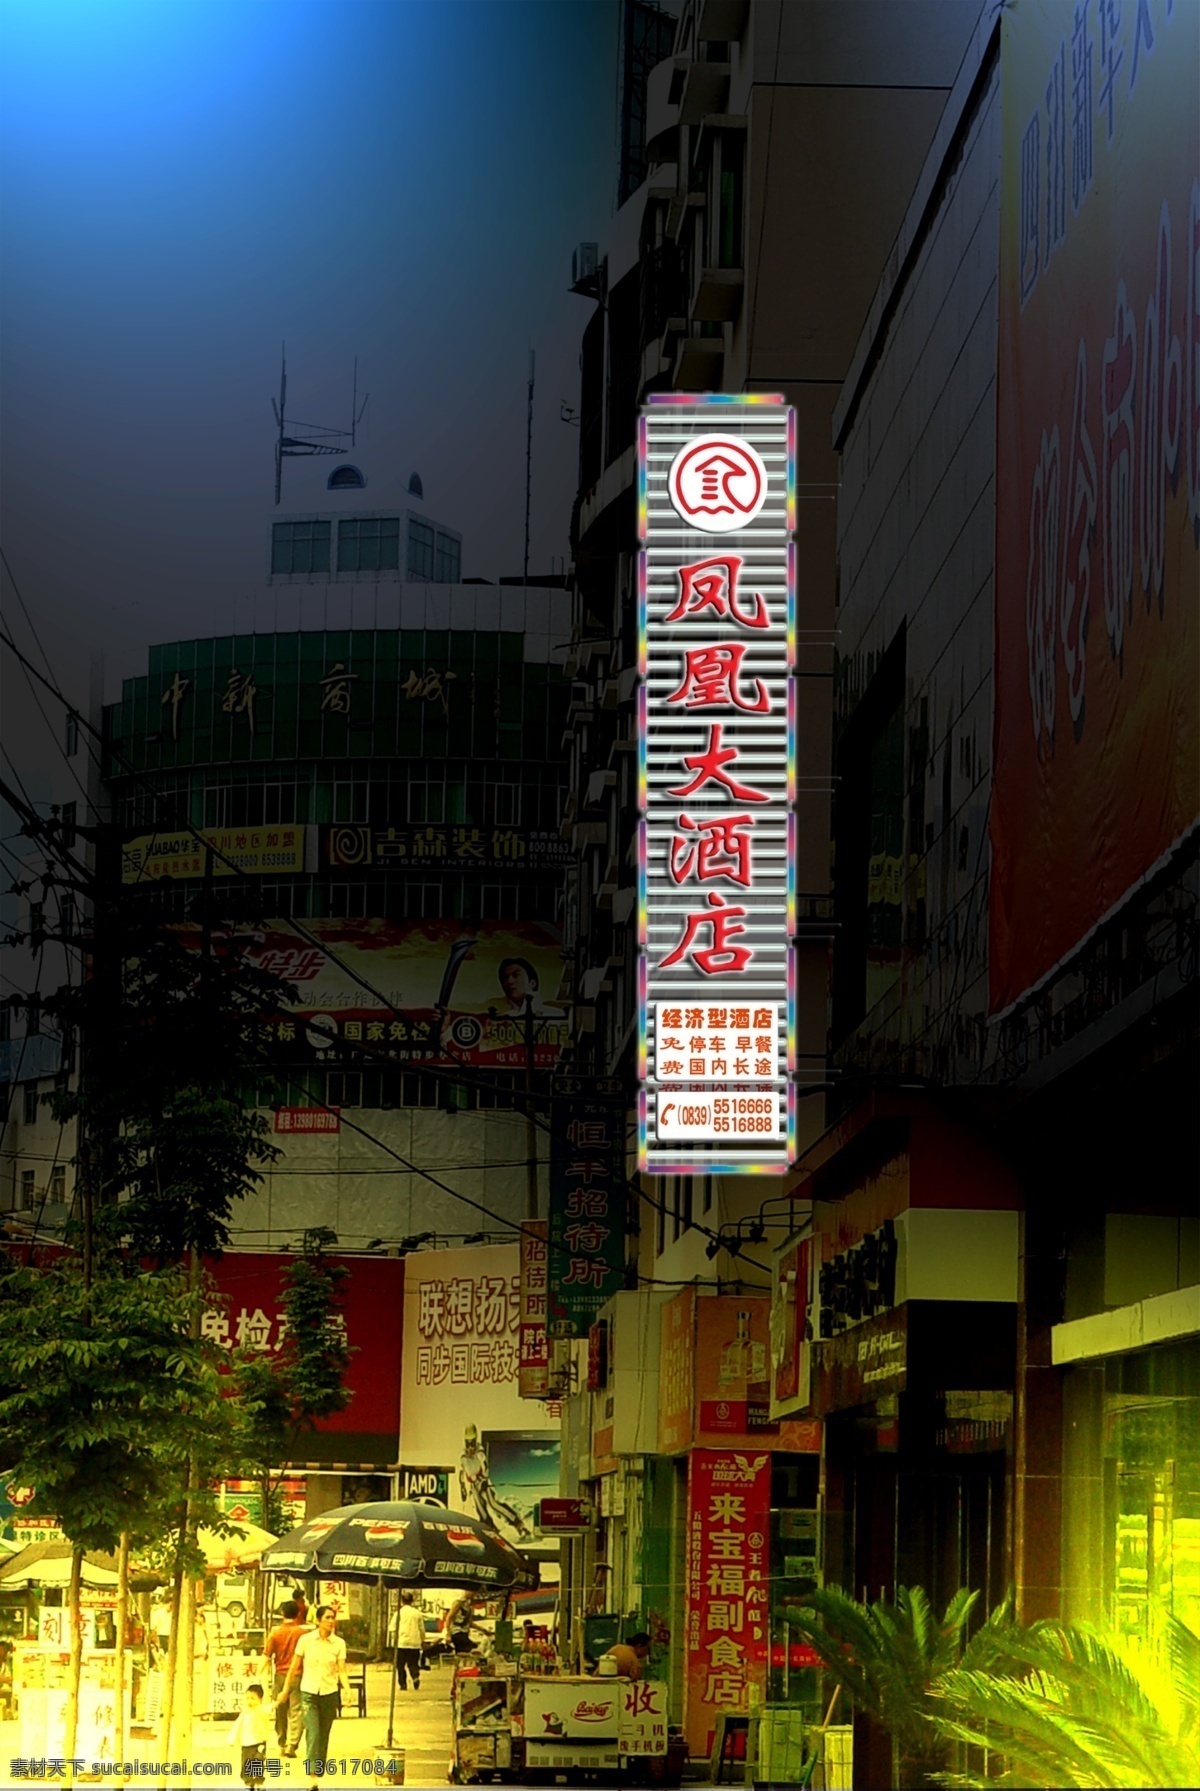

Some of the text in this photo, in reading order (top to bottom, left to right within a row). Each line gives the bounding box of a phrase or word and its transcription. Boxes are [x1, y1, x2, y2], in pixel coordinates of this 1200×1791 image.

[657, 555, 771, 975] 凤凰大酒店
[375, 826, 526, 860] 吉森装饰
[661, 1008, 774, 1030] 经济型酒店
[689, 1058, 773, 1076] 国内长途
[677, 1099, 773, 1126] (0839) 5516666
[713, 1117, 773, 1132] 5516888
[524, 1241, 547, 1318] 招待所
[416, 1340, 520, 1385] 同步国际技
[409, 1474, 437, 1494] AMD
[347, 1517, 413, 1532] PEPSI
[702, 1492, 747, 1705] 来宝福副食店
[624, 1682, 662, 1718] 收
